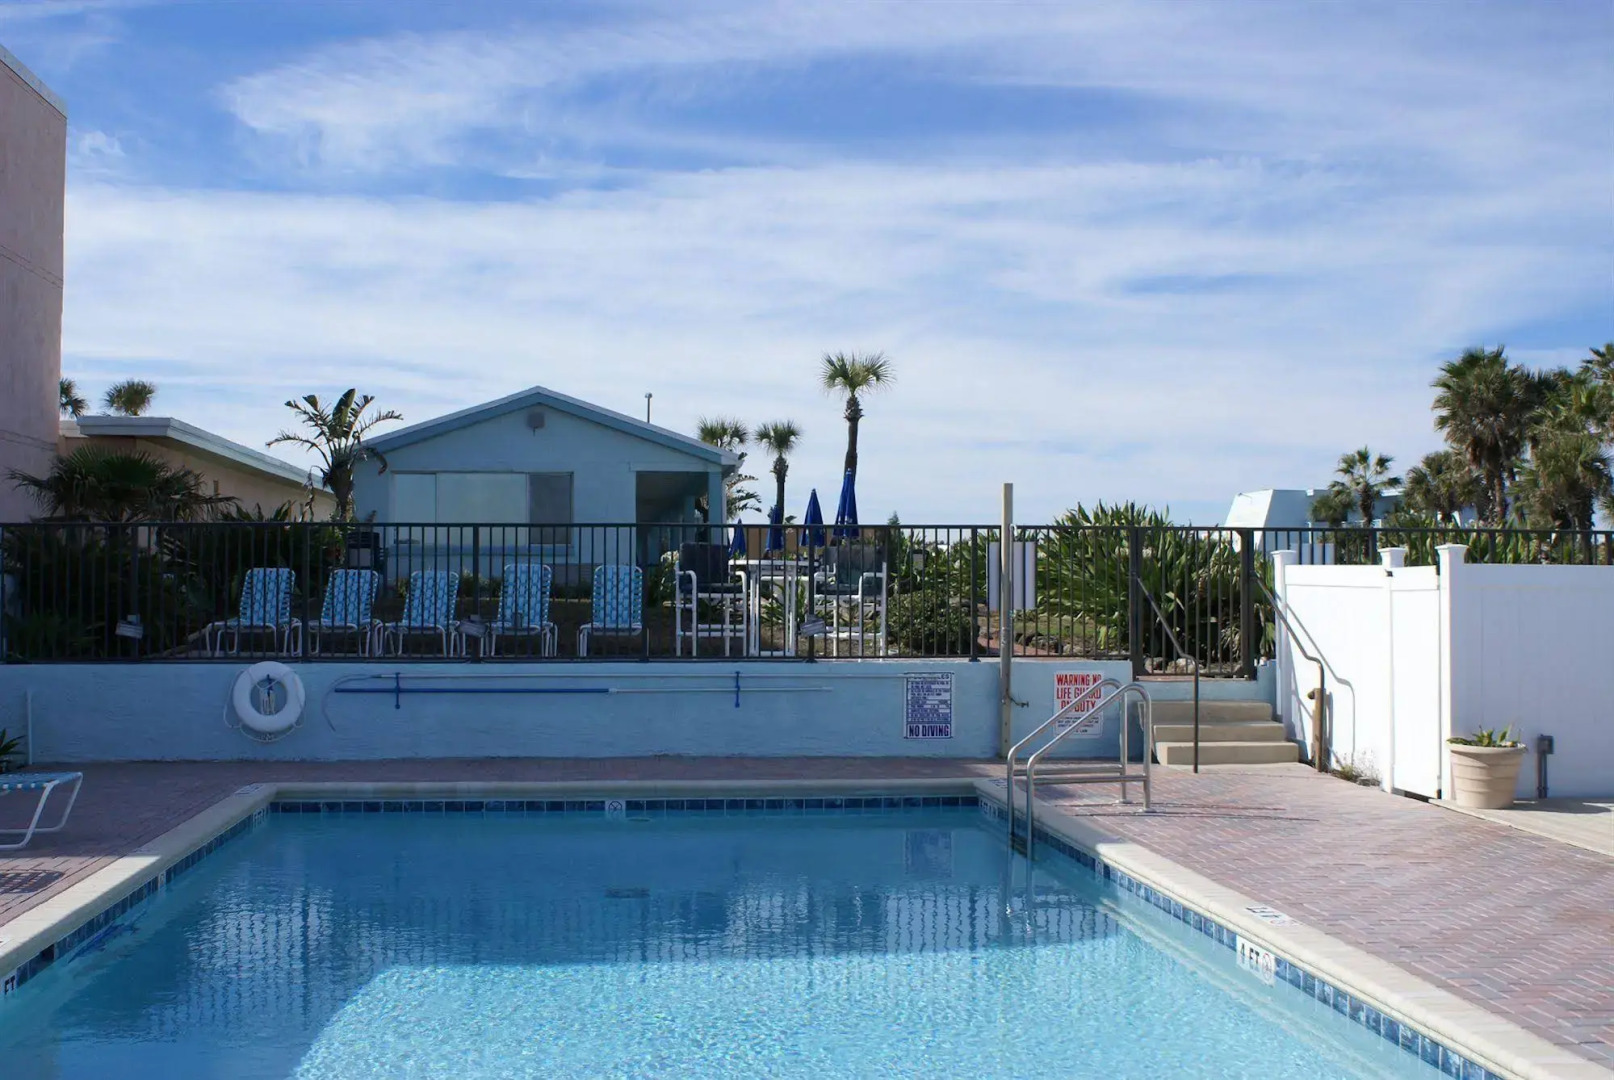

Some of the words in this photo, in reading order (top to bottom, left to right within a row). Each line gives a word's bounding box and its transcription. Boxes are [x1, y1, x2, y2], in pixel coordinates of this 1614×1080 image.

[1056, 674, 1090, 686] WARNING
[1056, 687, 1071, 699] LIFE
[1074, 687, 1102, 699] GUD
[909, 724, 920, 737] NO
[921, 724, 949, 737] DIVING
[1240, 943, 1246, 957] 4
[1249, 947, 1260, 965] FT
